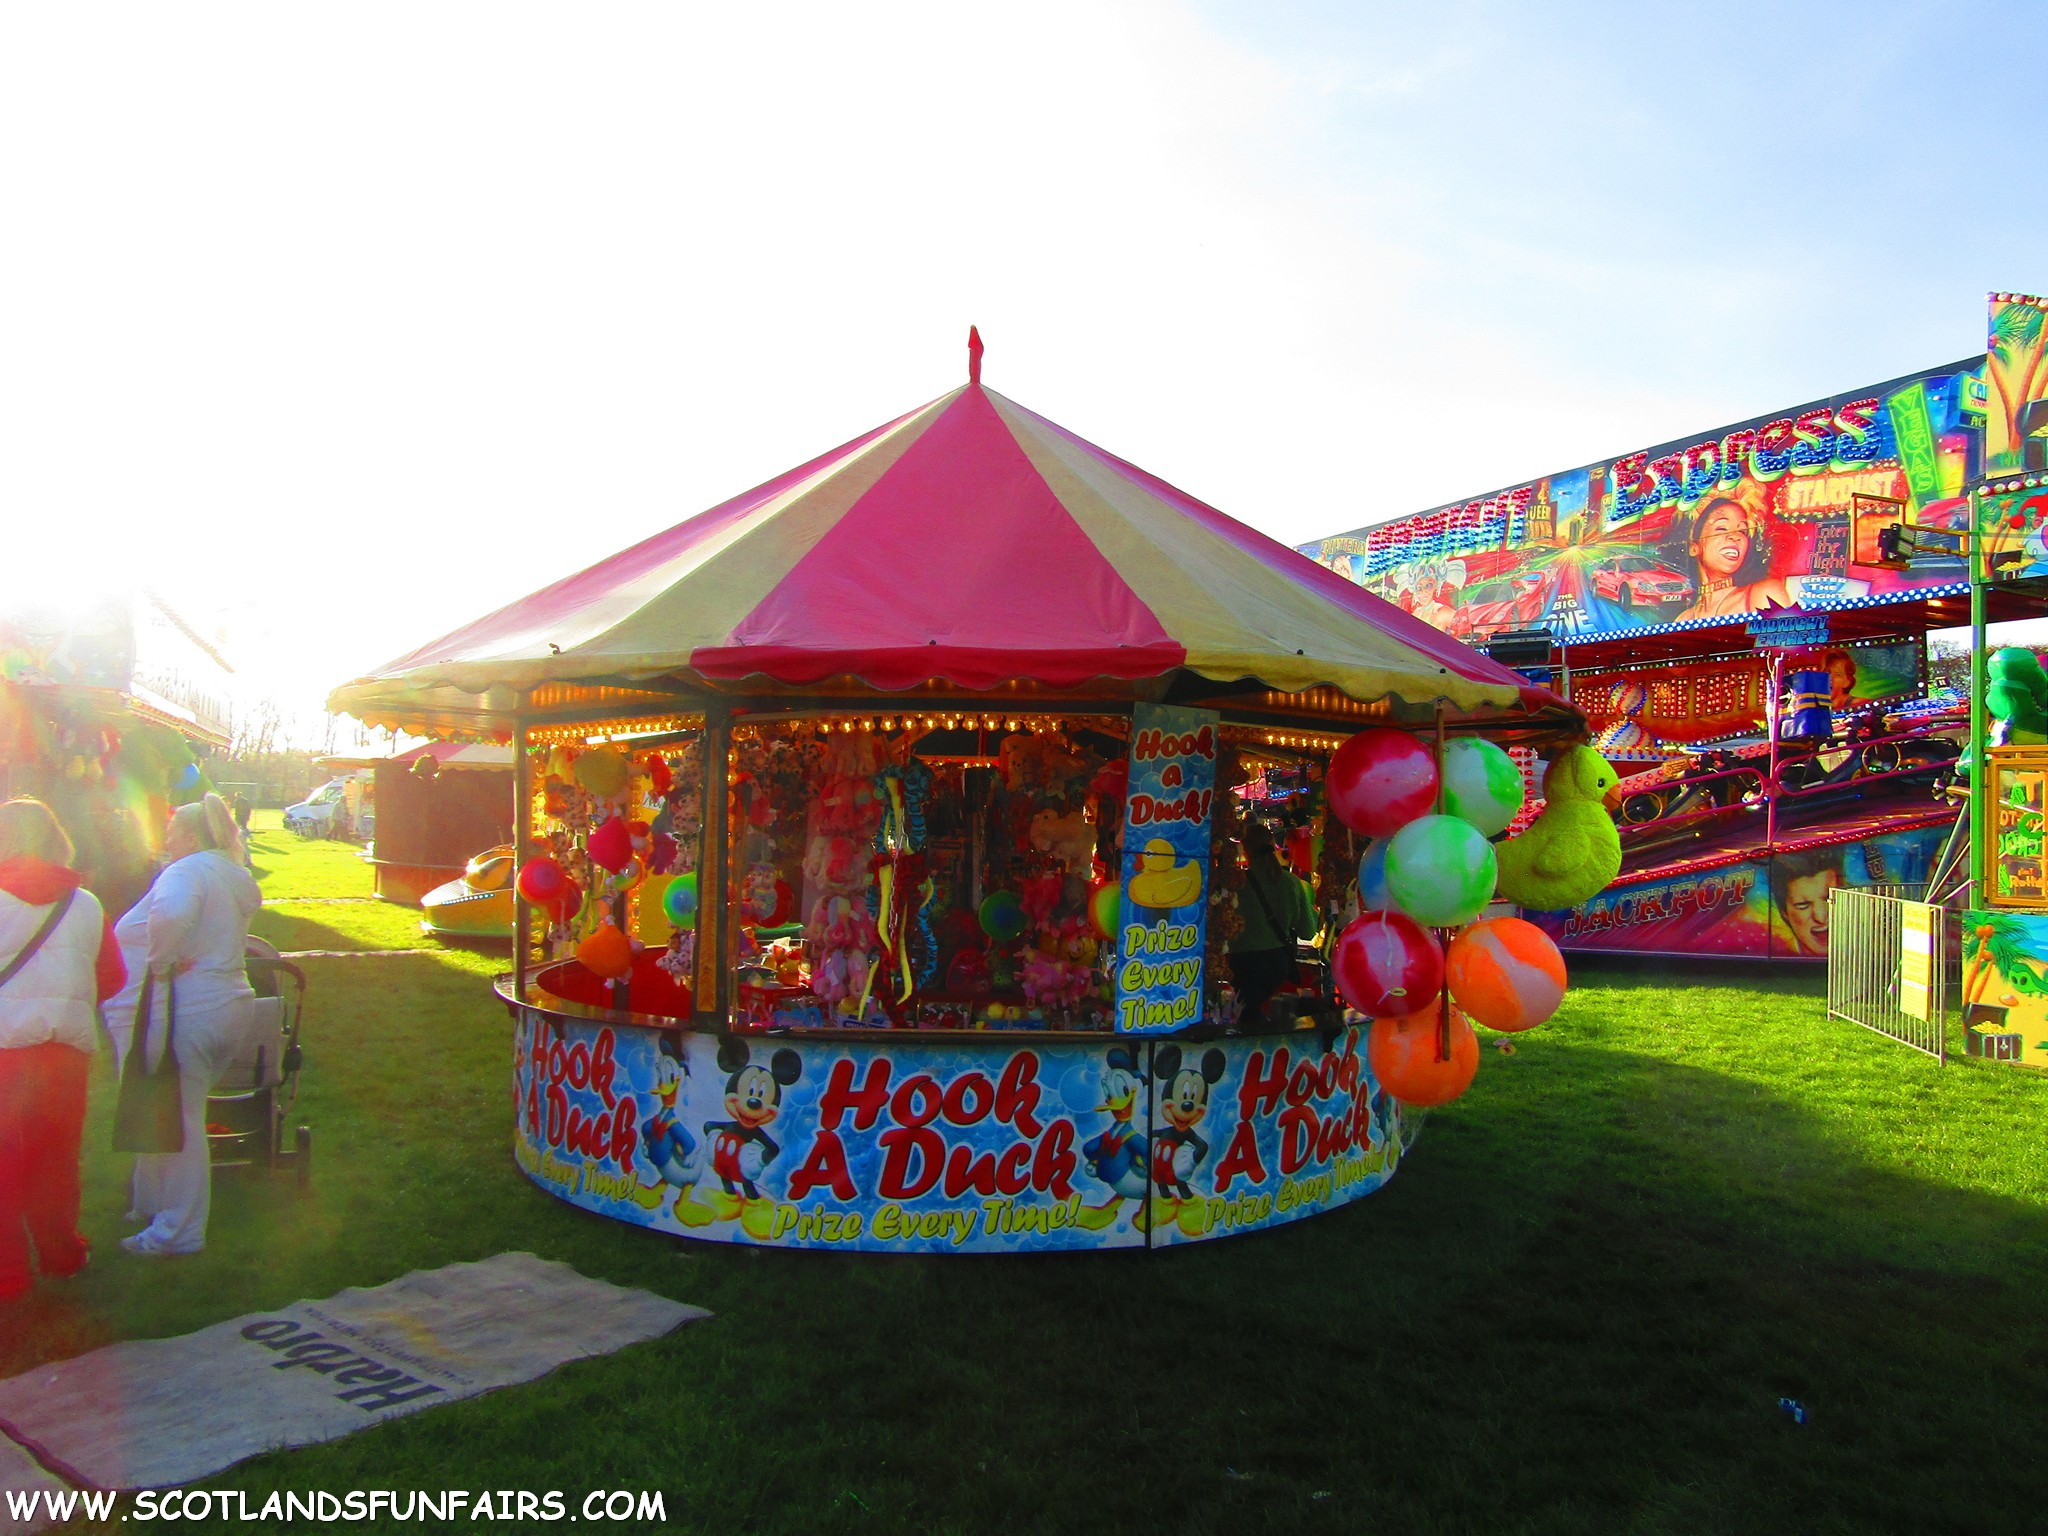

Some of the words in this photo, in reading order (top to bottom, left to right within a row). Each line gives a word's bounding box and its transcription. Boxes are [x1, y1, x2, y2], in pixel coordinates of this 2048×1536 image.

[1890, 387, 1934, 492] VEGAS
[1788, 471, 1898, 509] STARDUST
[1815, 521, 1849, 539] Enter
[1817, 536, 1841, 554] the
[1806, 550, 1846, 577] Night
[1540, 609, 1598, 637] ONE
[1552, 599, 1578, 611] BIG
[1744, 615, 1830, 635] MIDNIGHT
[1754, 629, 1831, 649] EXPRESS
[1651, 677, 1688, 718] THE
[1695, 671, 1750, 718] FAST
[1134, 726, 1215, 761] Hook
[1161, 763, 1182, 788] a
[1130, 789, 1212, 824] Duck!
[1564, 869, 1756, 937] JACKPOT
[1126, 923, 1197, 956] Prize
[1121, 958, 1201, 993] Every
[1121, 989, 1198, 1029] Time!
[531, 1019, 617, 1111] Hook
[1238, 1028, 1360, 1121] Hook
[820, 1051, 1043, 1140] Hook
[526, 1076, 540, 1139] A
[546, 1084, 638, 1175] Duck
[1214, 1120, 1267, 1192] A
[1278, 1081, 1371, 1175] Duck
[789, 1130, 859, 1201] A
[879, 1119, 1075, 1201] Duck
[584, 1160, 639, 1202] Time!
[773, 1203, 862, 1241] Prize
[872, 1204, 982, 1245] Every
[983, 1194, 1081, 1235] Time!
[1204, 1190, 1273, 1233] Prize
[1275, 1175, 1332, 1205] Every
[239, 1319, 447, 1413] Harbro
